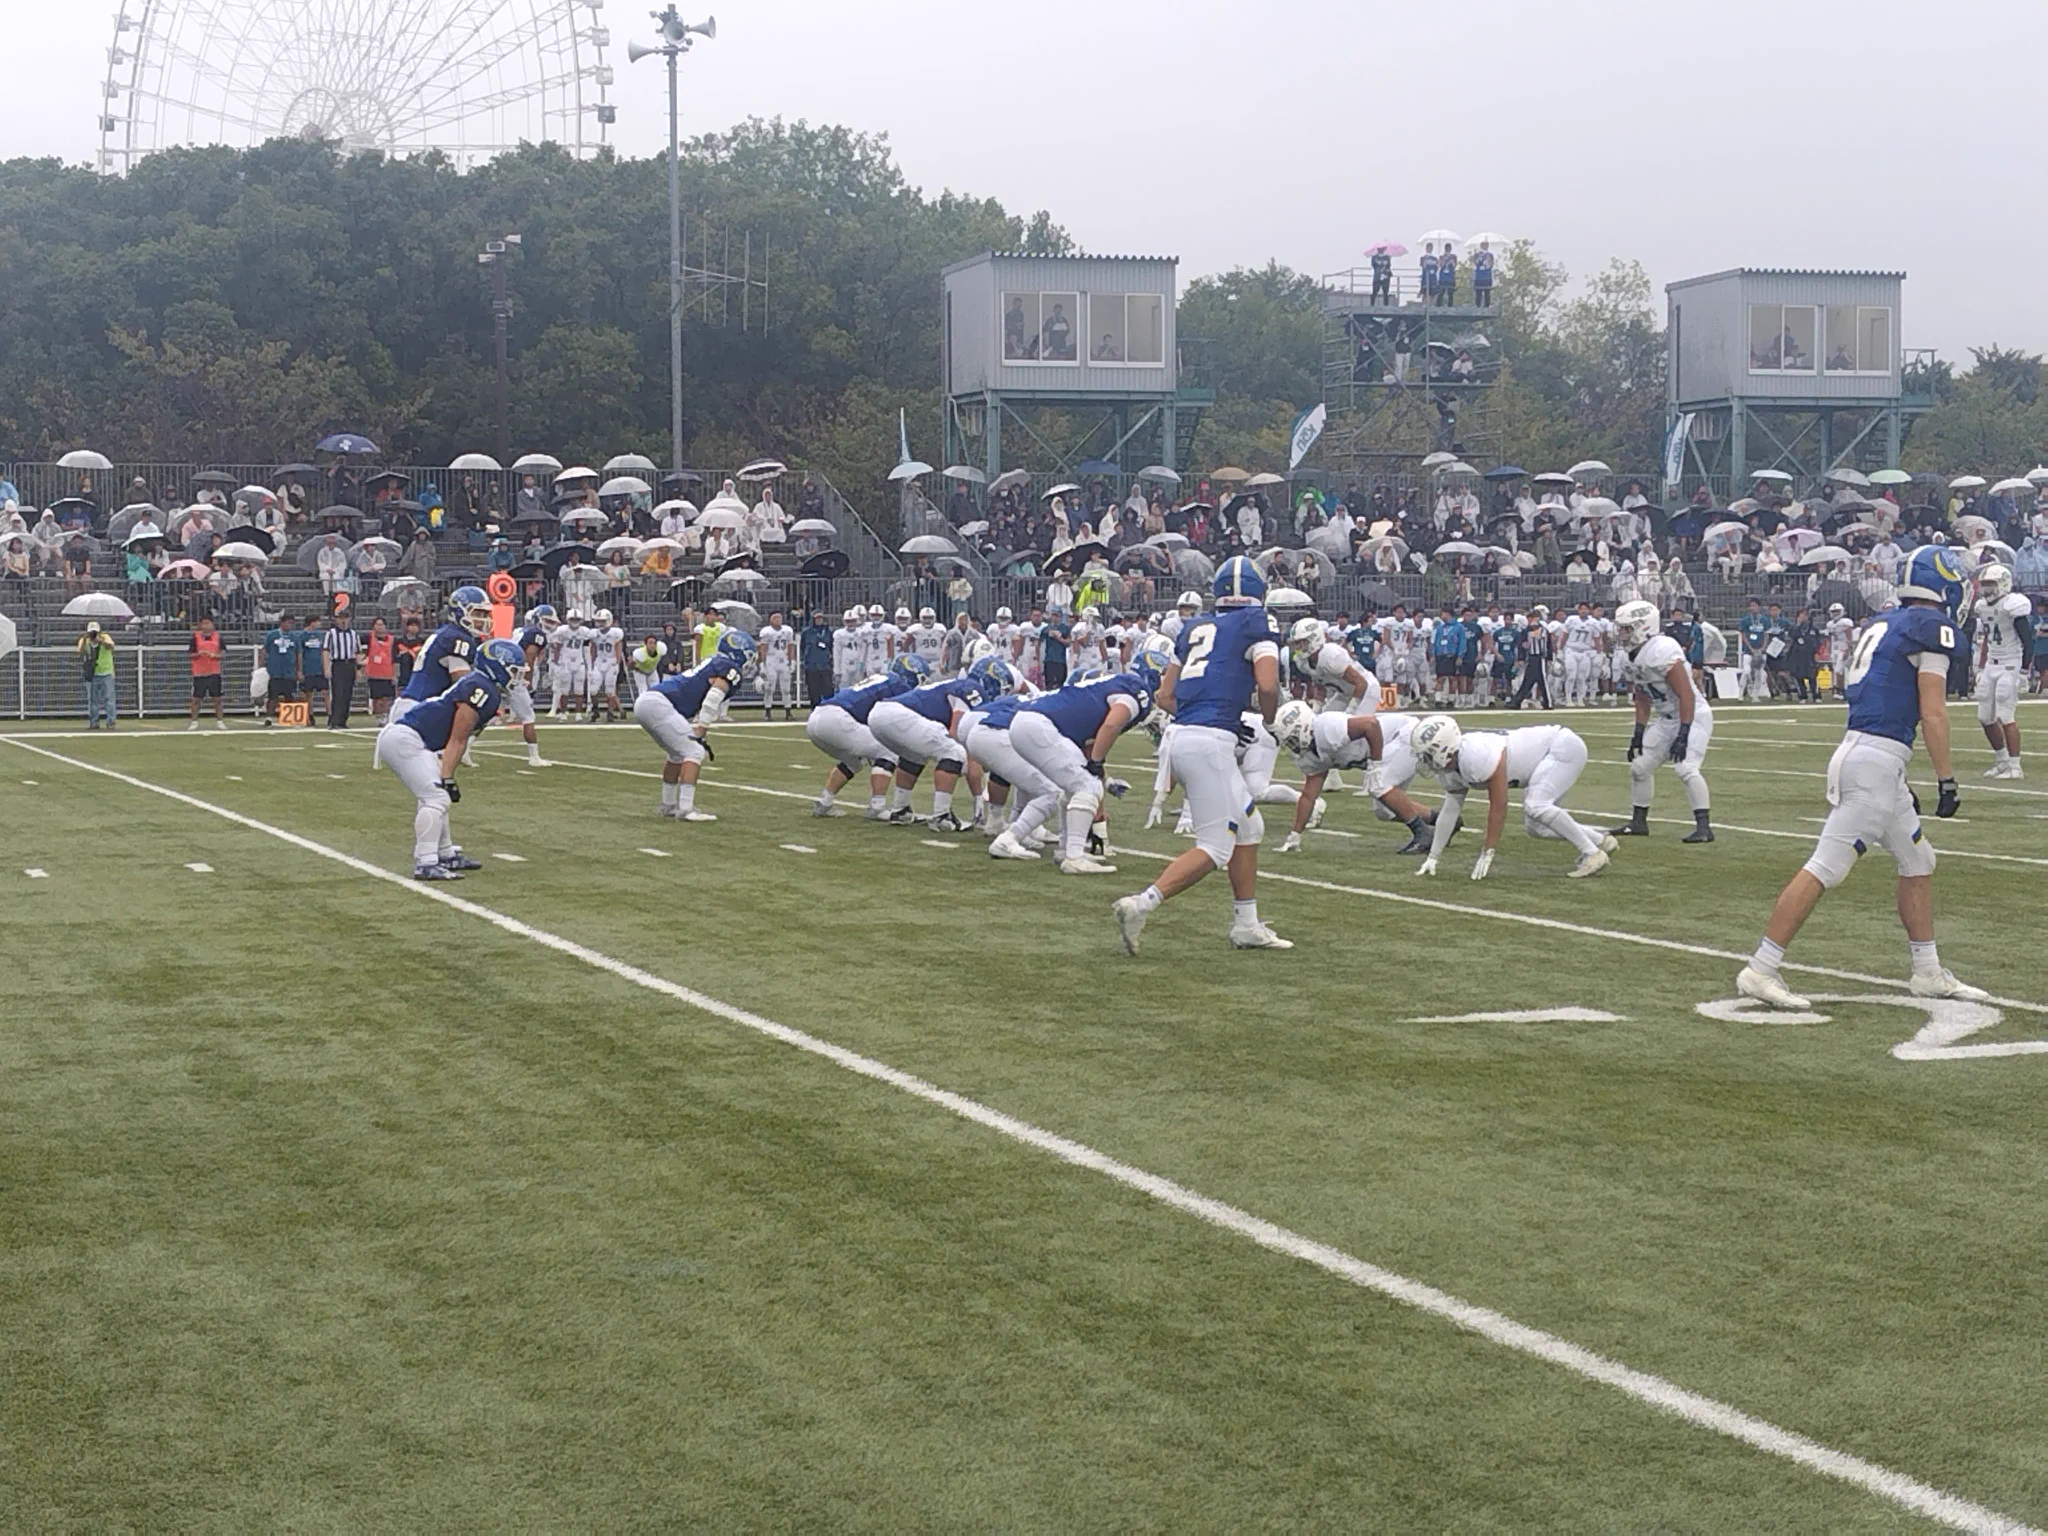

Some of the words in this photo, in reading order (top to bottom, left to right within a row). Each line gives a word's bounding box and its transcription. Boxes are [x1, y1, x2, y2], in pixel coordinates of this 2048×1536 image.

[1575, 629, 1589, 643] 77
[1939, 625, 1955, 649] 0
[1180, 622, 1218, 681] 2
[469, 687, 489, 708] 31
[282, 704, 305, 723] 20
